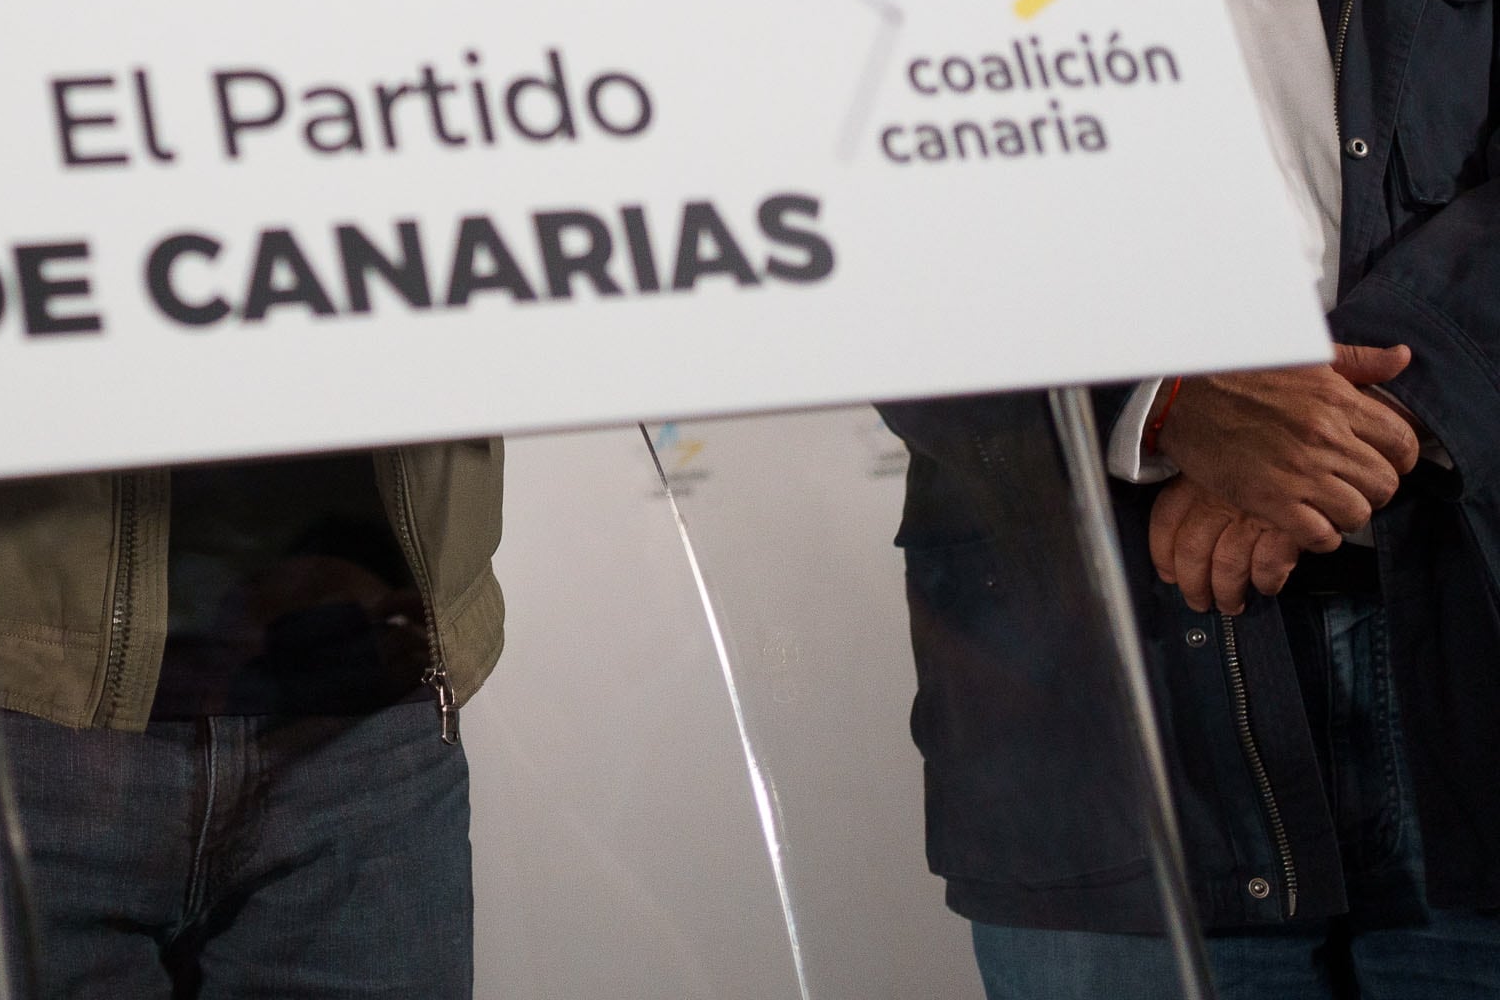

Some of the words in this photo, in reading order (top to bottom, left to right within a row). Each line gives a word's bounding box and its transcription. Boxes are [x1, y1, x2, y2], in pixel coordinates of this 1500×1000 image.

[51, 69, 175, 167] El
[213, 48, 653, 158] Partido
[907, 32, 1179, 95] coalición
[880, 100, 1107, 163] canaria
[143, 193, 835, 329] CANARIAS
